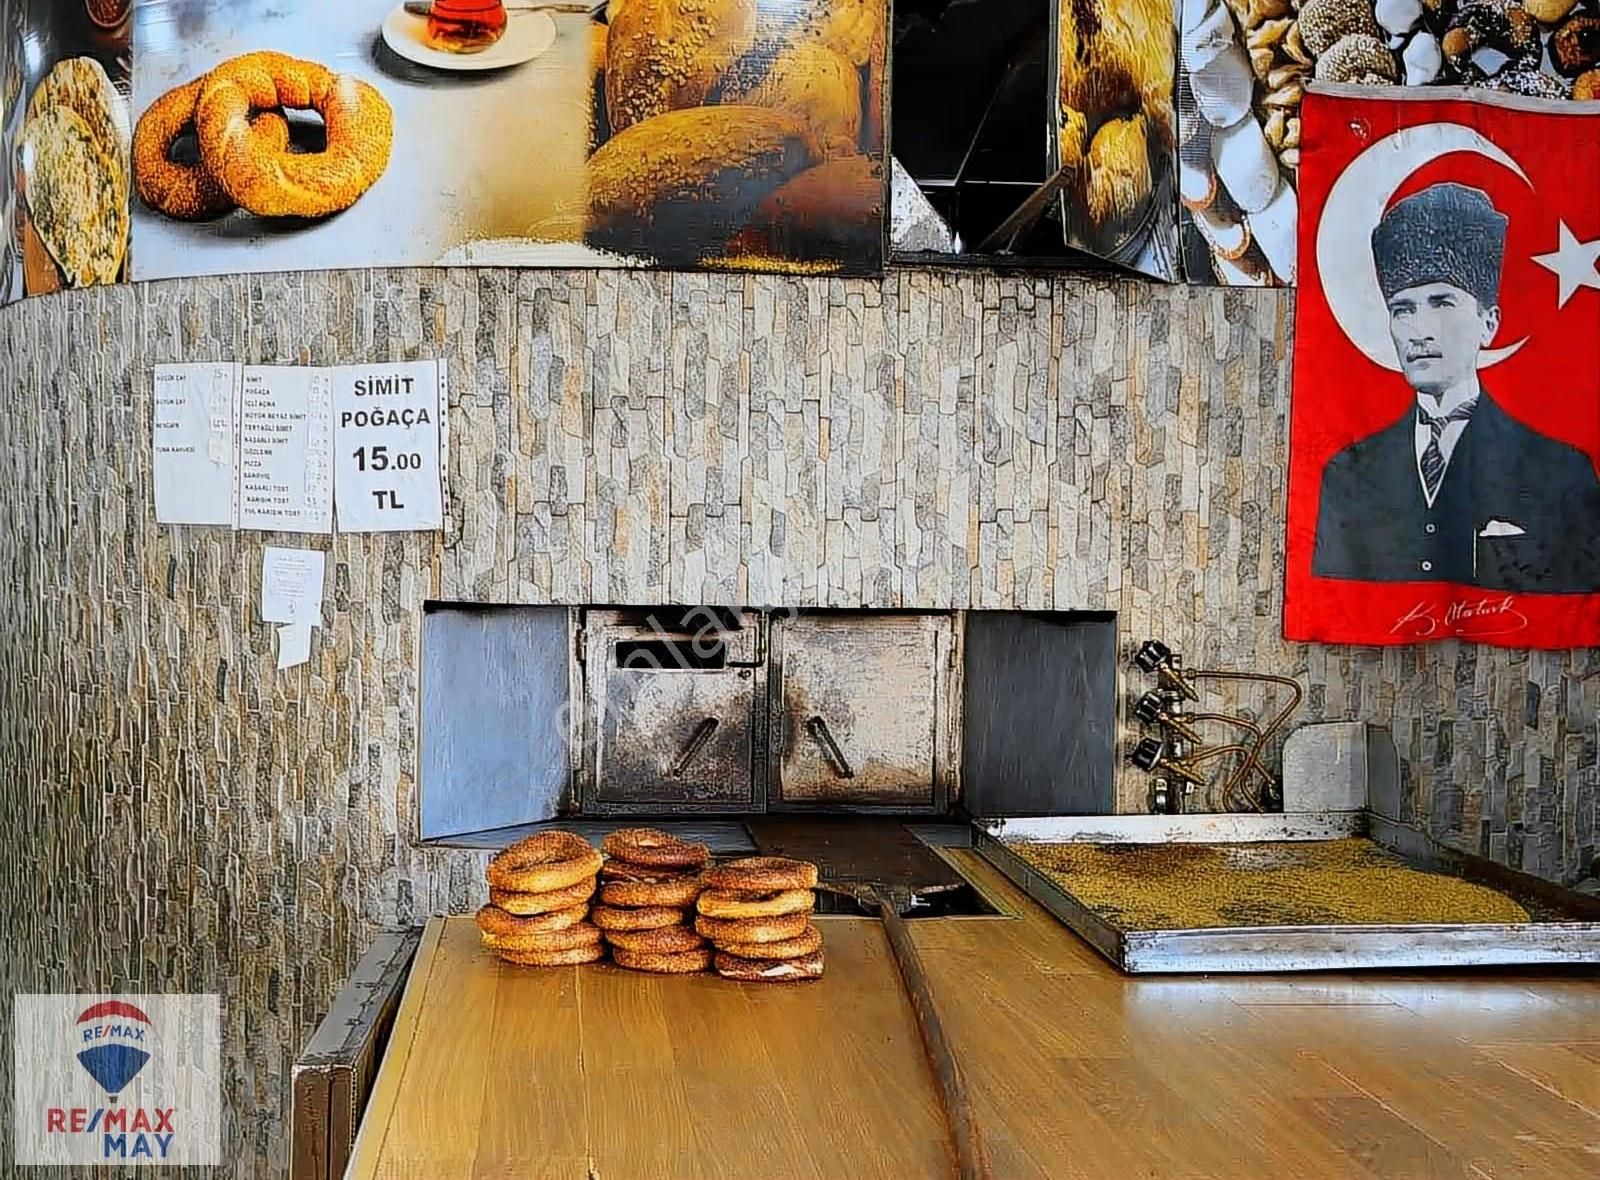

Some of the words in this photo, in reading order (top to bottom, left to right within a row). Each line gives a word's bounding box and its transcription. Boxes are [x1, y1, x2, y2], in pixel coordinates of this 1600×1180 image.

[354, 374, 414, 397] SİMİT
[341, 406, 431, 430] POĞAÇA
[353, 446, 422, 472] 15.00
[372, 490, 405, 510] TL
